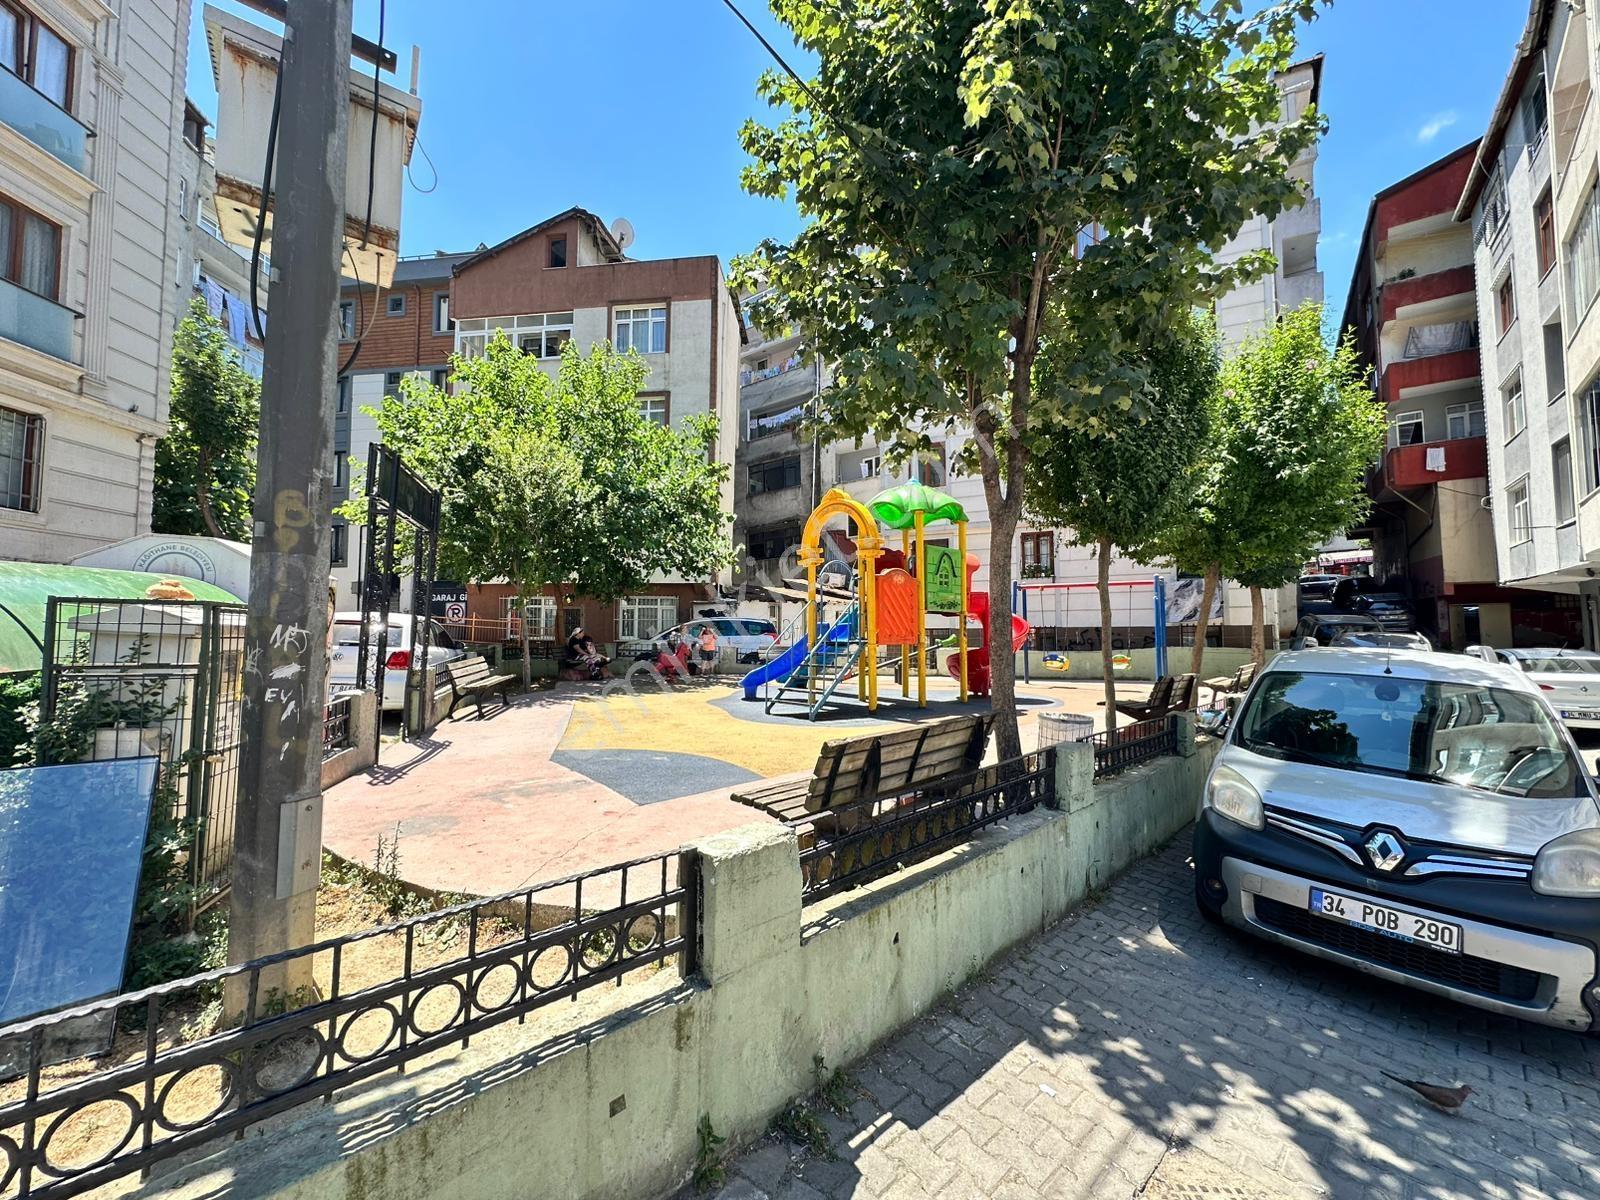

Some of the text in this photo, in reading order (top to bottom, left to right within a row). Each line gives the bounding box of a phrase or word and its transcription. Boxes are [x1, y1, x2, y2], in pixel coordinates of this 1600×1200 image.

[1323, 895, 1453, 945] 34 POB 290
